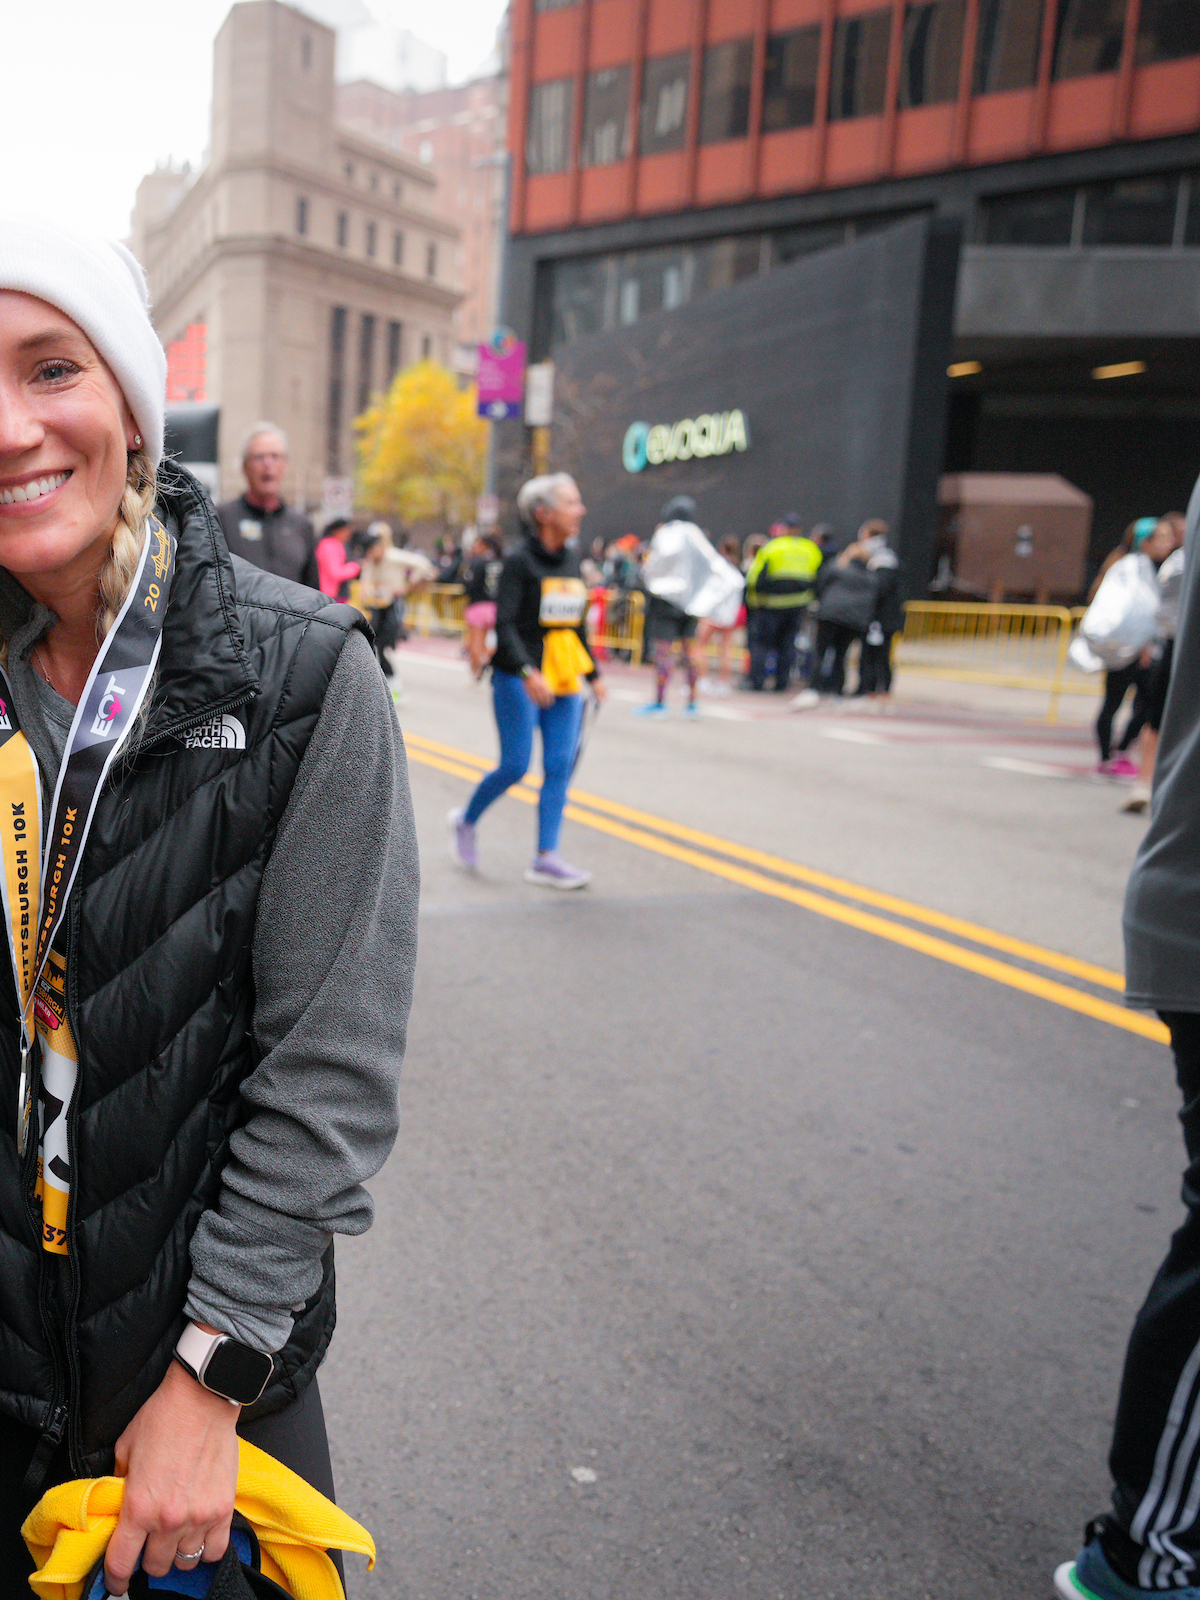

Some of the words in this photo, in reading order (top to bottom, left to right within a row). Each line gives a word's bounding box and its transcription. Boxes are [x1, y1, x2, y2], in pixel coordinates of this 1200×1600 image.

[144, 583, 160, 613] 20
[90, 674, 126, 737] EQT
[185, 736, 221, 749] FACE
[11, 802, 26, 841] 10K
[61, 806, 78, 845] 10K
[16, 850, 30, 991] PITTSBURGH
